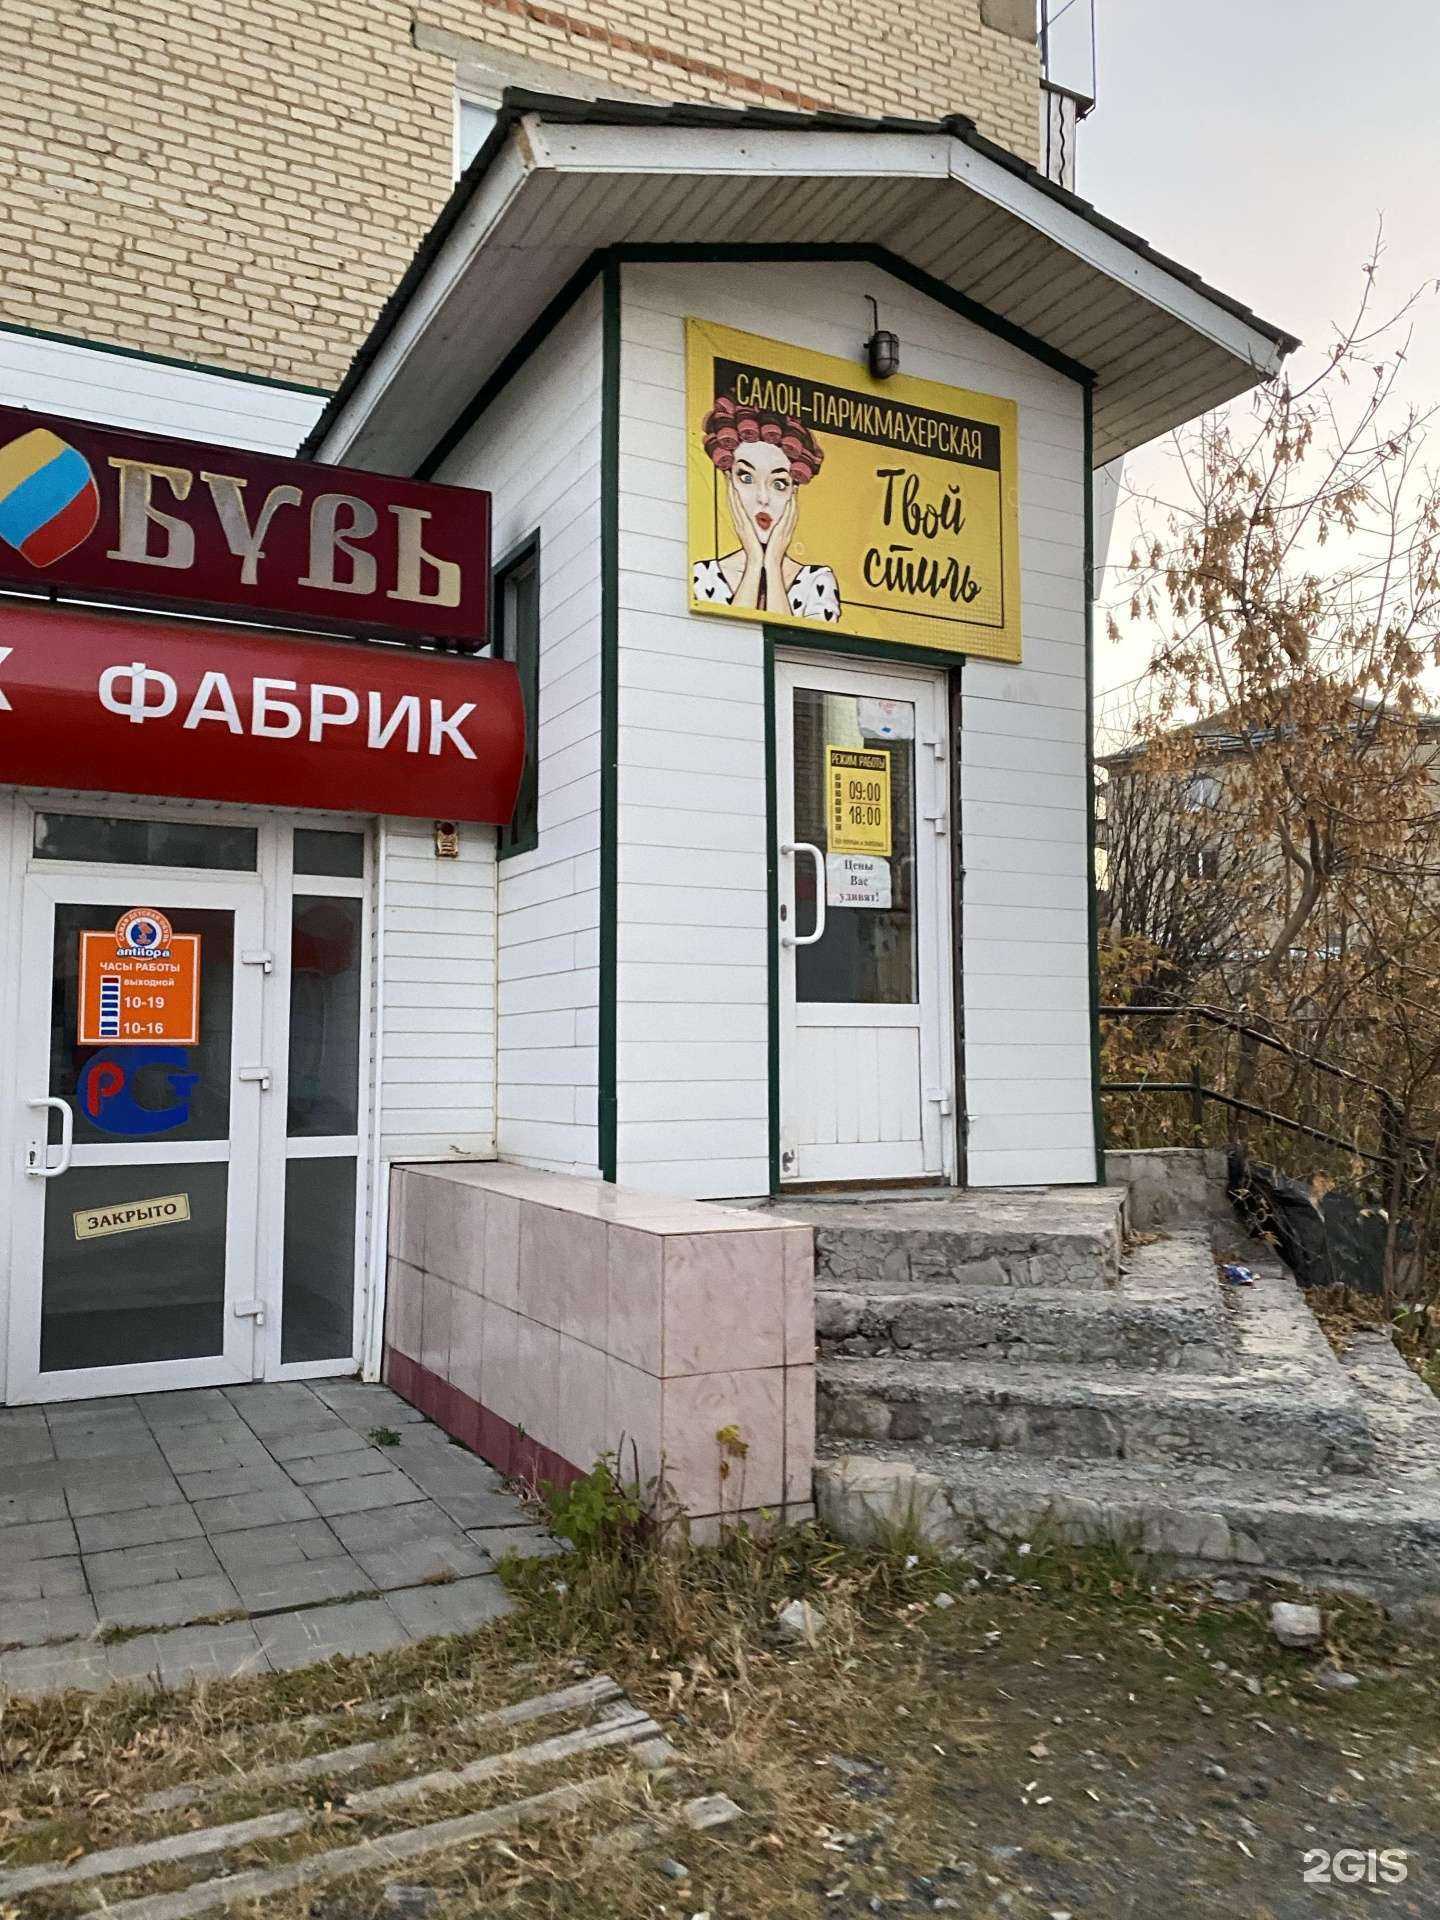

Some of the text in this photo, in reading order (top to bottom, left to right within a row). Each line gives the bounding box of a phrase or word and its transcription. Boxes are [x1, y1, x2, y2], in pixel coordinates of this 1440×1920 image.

[736, 373, 983, 460] САЛОН-ПАРИКМАХЕРСКАЯ
[876, 468, 966, 539] Твой
[863, 544, 982, 604] стиль
[98, 661, 479, 761] ФАБРИК
[849, 780, 881, 802] 09:00
[848, 805, 881, 827] 18:00
[844, 859, 874, 872] Цены
[850, 875, 869, 886] Вас
[100, 961, 180, 973] ЧАСЫ РАБОТЫ
[123, 978, 175, 988] выходной
[124, 996, 165, 1009] 10-19
[123, 1022, 164, 1035] 10-16
[87, 1203, 177, 1230] ЗАКРЫТО
